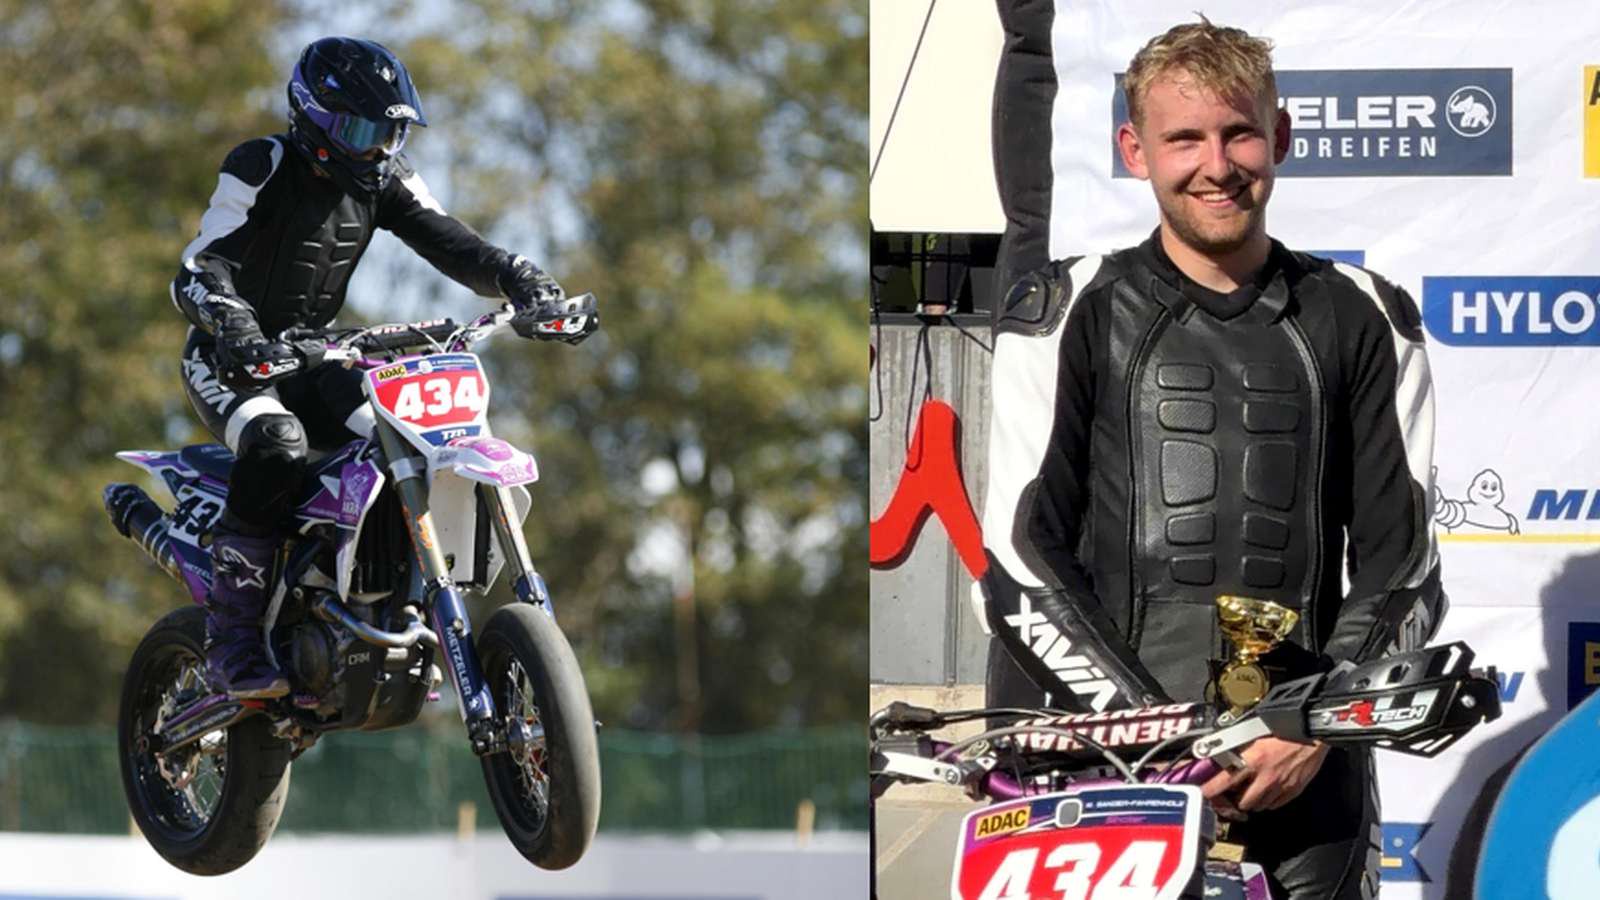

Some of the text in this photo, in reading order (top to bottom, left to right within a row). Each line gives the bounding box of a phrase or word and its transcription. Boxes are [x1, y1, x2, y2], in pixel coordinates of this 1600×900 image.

[377, 365, 405, 381] ADAC
[394, 376, 483, 420] 434
[173, 495, 221, 537] 43
[445, 627, 473, 697] METZELER
[977, 809, 1028, 837] ADAC
[977, 840, 1168, 900] 434
